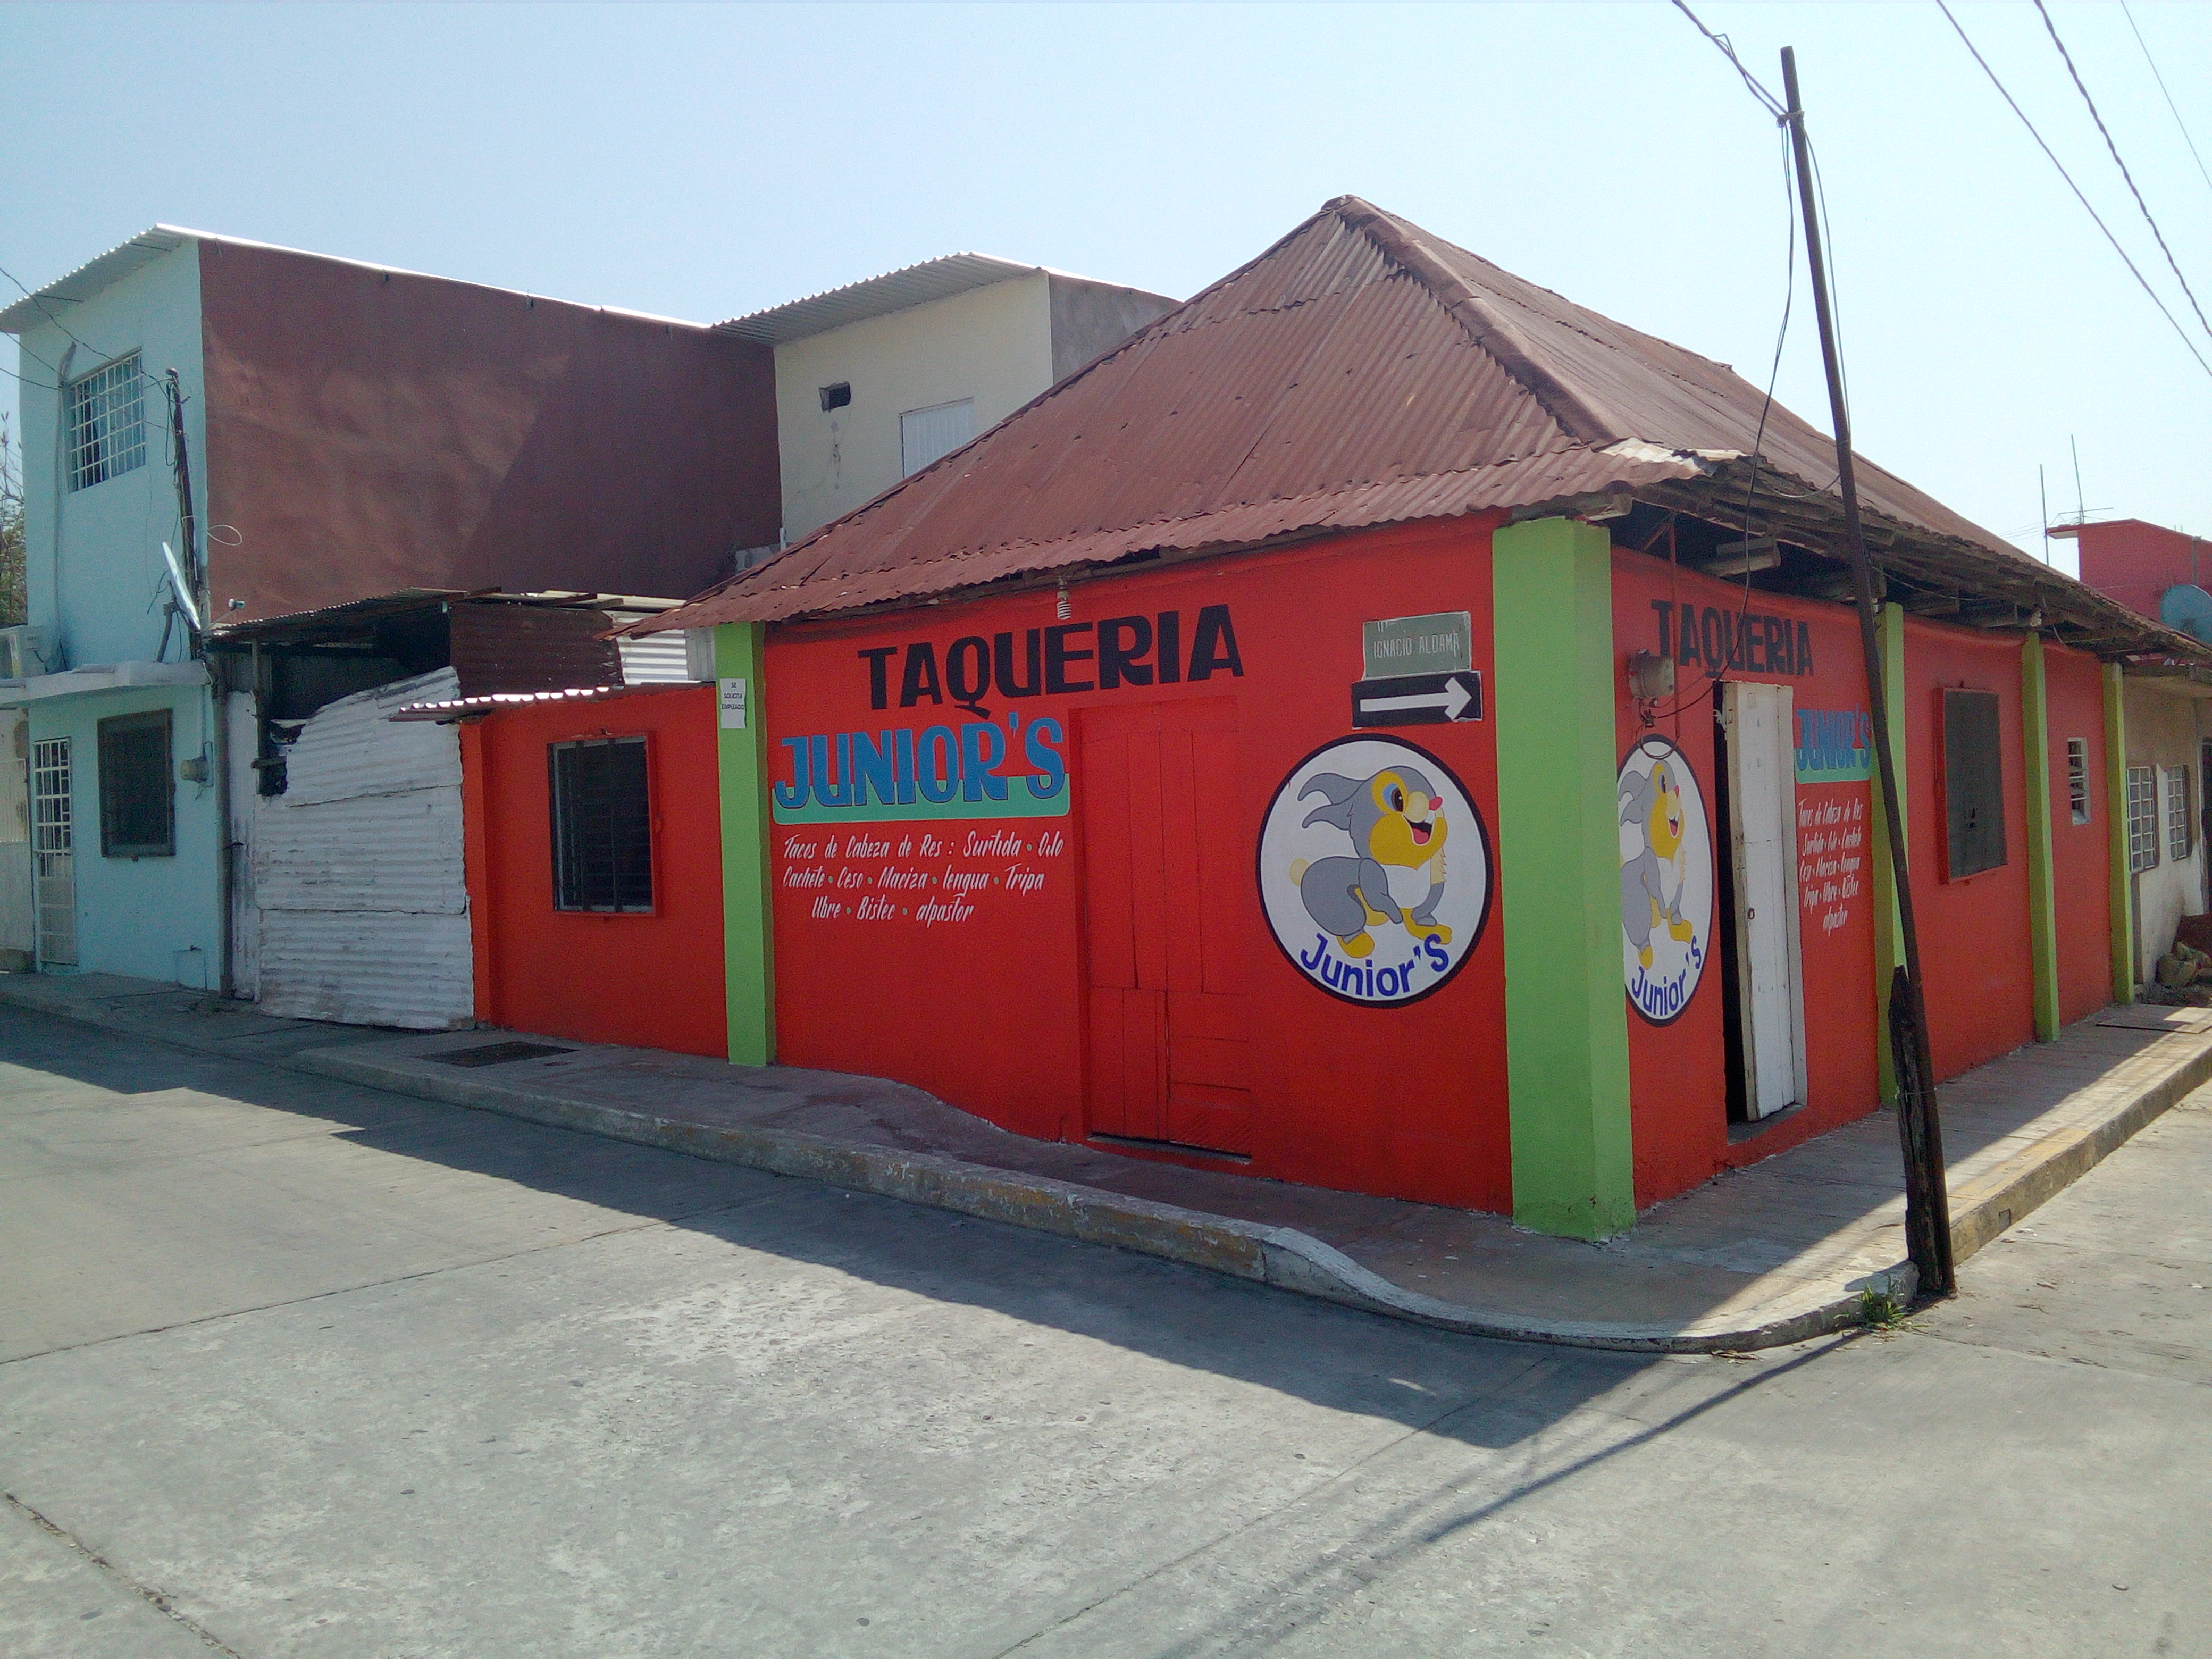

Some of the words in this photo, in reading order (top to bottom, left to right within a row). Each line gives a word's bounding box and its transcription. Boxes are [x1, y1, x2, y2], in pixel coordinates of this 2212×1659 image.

[857, 604, 1244, 718] TAQUERIA
[1373, 638, 1412, 659] IGNACIO
[1419, 632, 1460, 657] ALDAMA
[1651, 599, 1814, 678] TAQUERIA
[775, 712, 1065, 809] JUNIOR'S
[1796, 703, 1872, 771] JUNIOR'S
[784, 834, 817, 859] Tacos
[825, 834, 838, 859] de
[845, 833, 890, 858] Cabeza
[898, 834, 912, 858] de
[963, 829, 1022, 857] Surtida
[783, 866, 825, 888] Cachete
[837, 866, 864, 888] Ceso
[877, 866, 928, 889] Maciza
[942, 864, 990, 897] lengua
[1004, 863, 1045, 896] Tripa
[811, 895, 842, 919] Ubre
[856, 894, 896, 920] Bistec
[916, 895, 975, 928] alpastor
